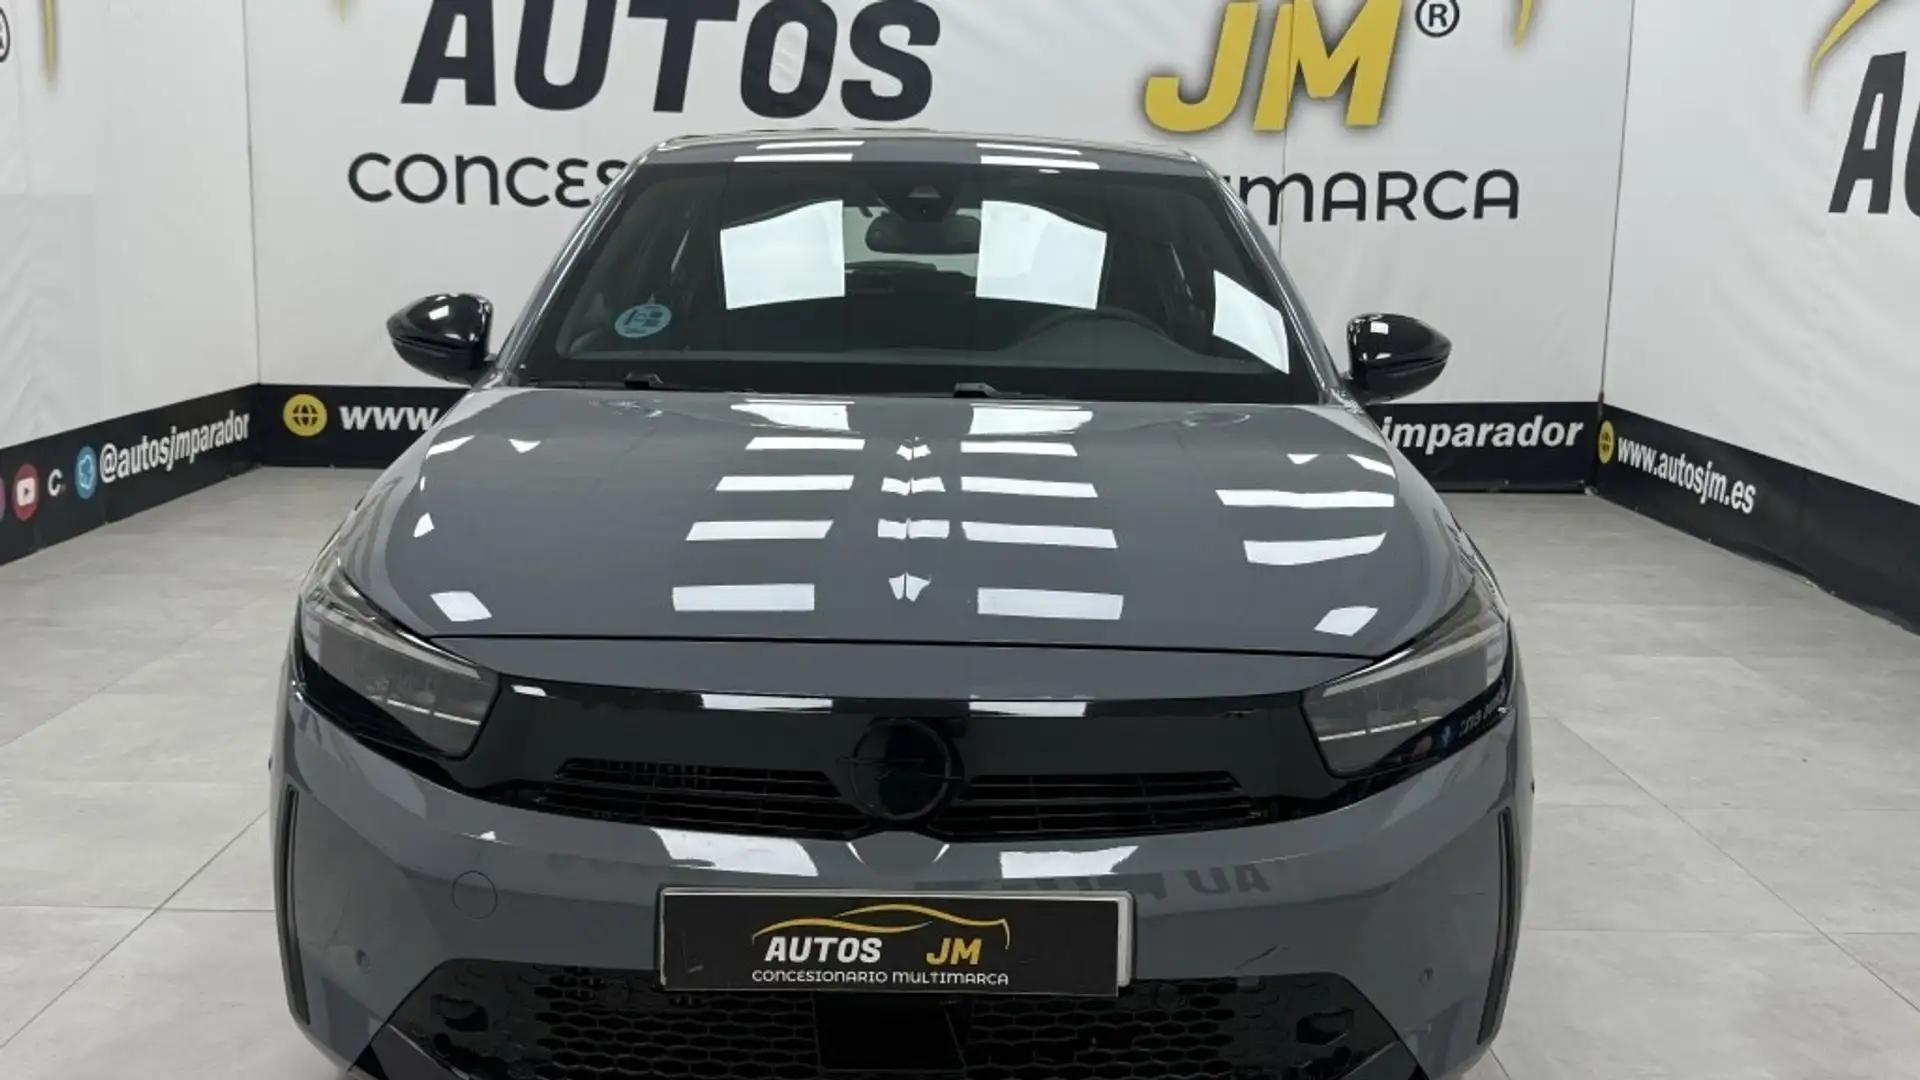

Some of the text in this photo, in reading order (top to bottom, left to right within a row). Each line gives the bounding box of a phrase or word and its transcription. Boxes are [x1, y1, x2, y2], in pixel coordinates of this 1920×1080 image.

[401, 0, 941, 121] AUTOS
[1144, 0, 1402, 132] JM
[1222, 169, 1520, 226] MARCA
[100, 409, 250, 484] @autosjmparador
[1618, 436, 1757, 515] www.autosjm.es
[752, 969, 1009, 986] CONCESIONARIO MULTIMARCA
[764, 936, 983, 965] AUTOS JM
